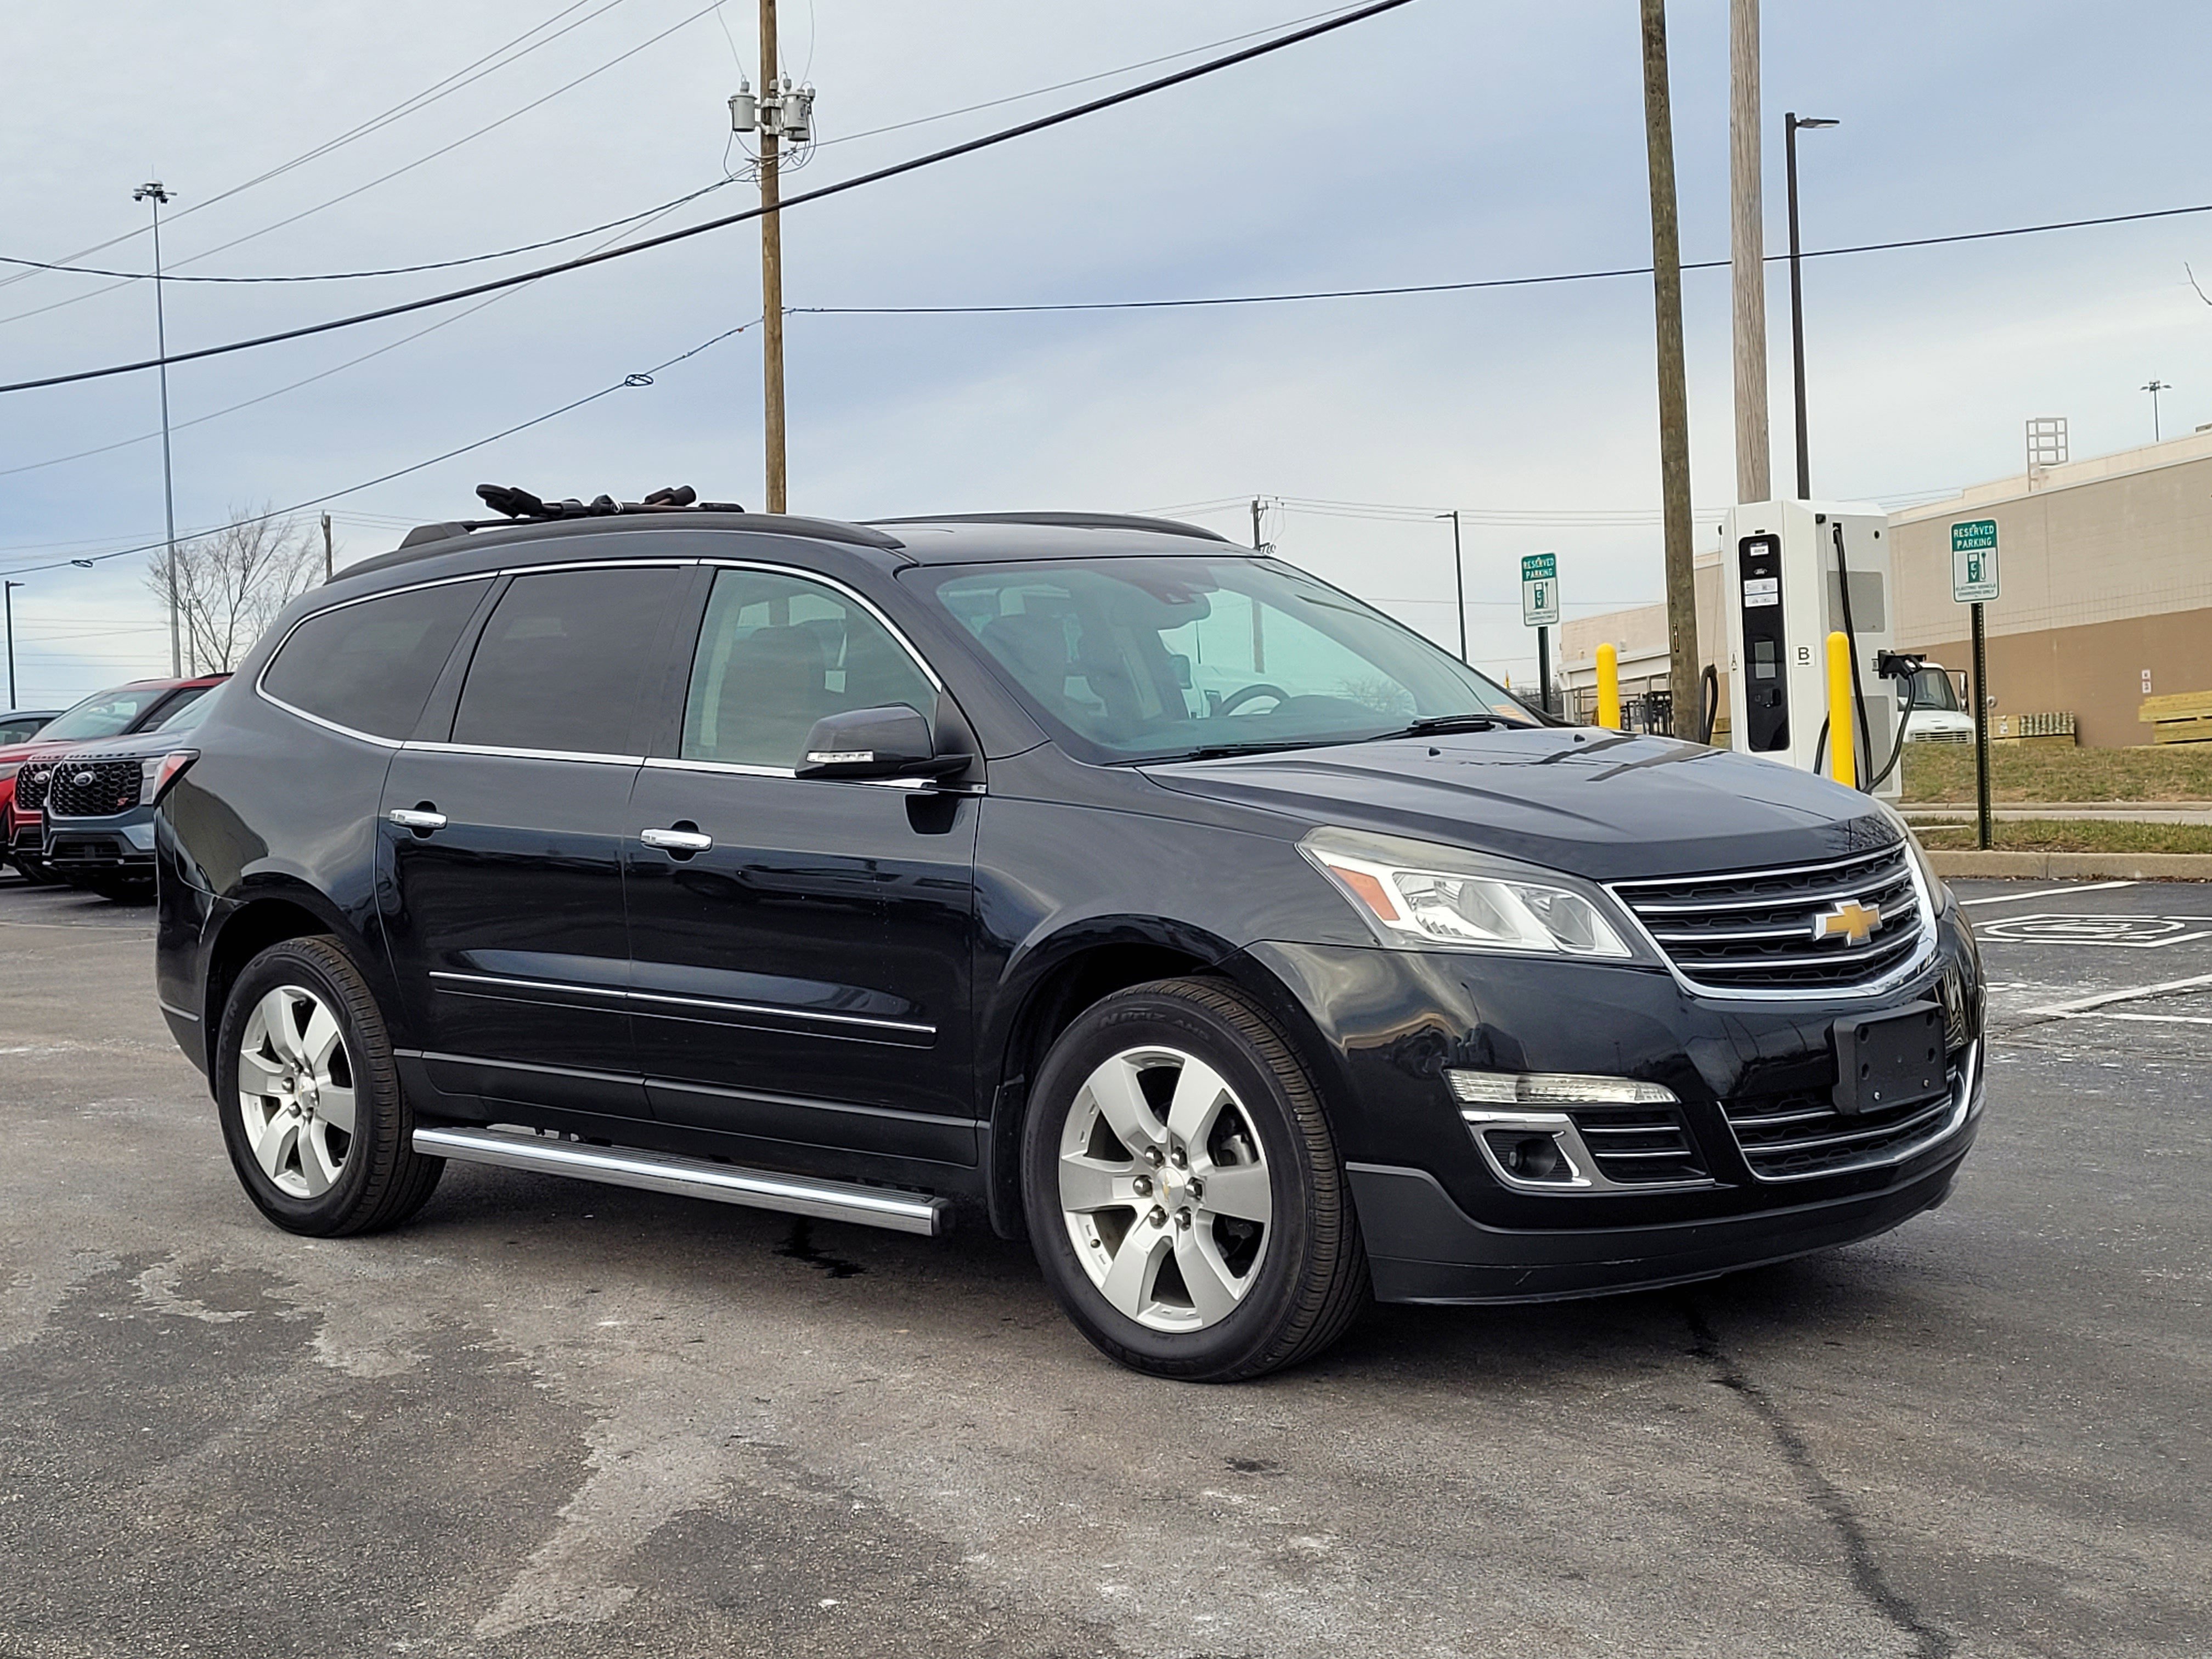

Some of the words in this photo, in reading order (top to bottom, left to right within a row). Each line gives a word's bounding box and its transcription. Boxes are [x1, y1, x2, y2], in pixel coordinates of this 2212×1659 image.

[1954, 525, 1994, 538] RESERVED
[1957, 537, 1992, 549] PARKING
[1523, 557, 1554, 569] RESERVED
[1526, 568, 1553, 579] PARKING
[1731, 652, 1737, 667] A
[1798, 647, 1809, 660] B
